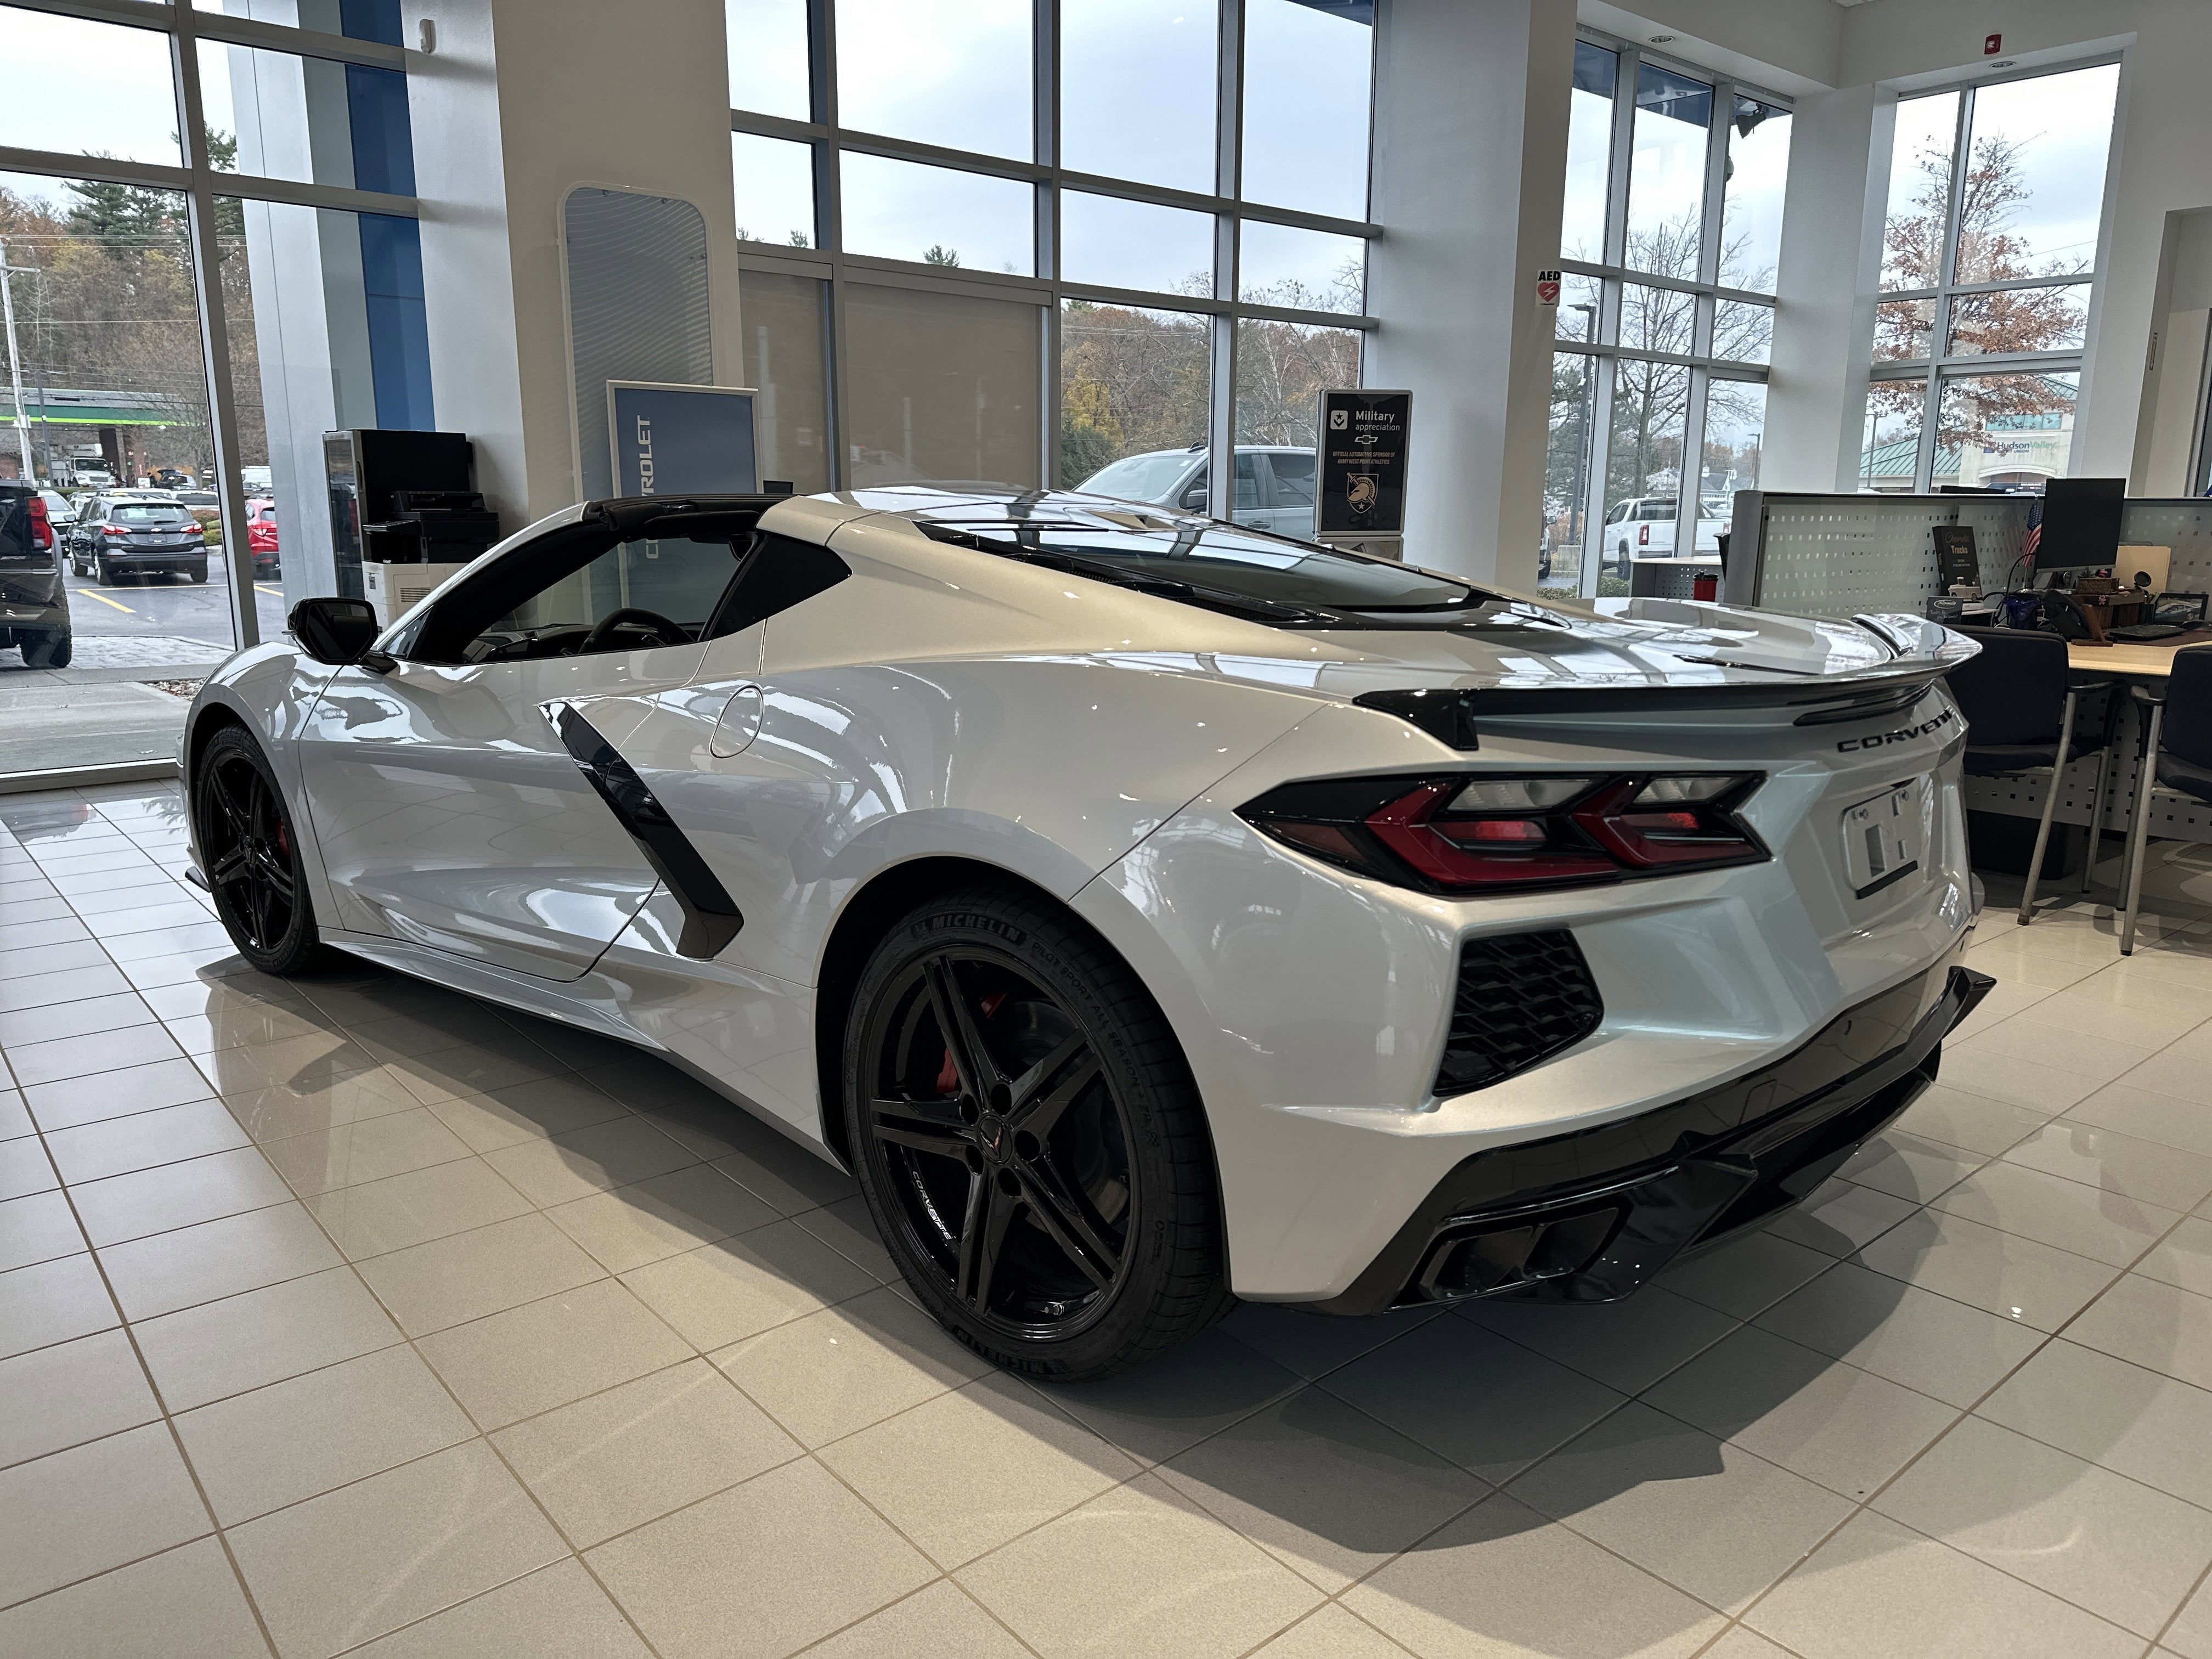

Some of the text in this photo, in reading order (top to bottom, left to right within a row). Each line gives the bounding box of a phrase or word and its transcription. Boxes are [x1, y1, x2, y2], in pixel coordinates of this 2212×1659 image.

[1538, 271, 1561, 281] AED
[1356, 410, 1395, 423] Military
[1355, 423, 1400, 432] appreciation
[1951, 545, 1968, 554] Trucks
[932, 915, 1021, 941] MICHELIN
[1031, 941, 1065, 967] PILOT
[1060, 967, 1093, 1001] SPORT
[1093, 1006, 1111, 1029] ALL
[1109, 1031, 1141, 1087] SEASON
[912, 1170, 952, 1240] CORVETTE
